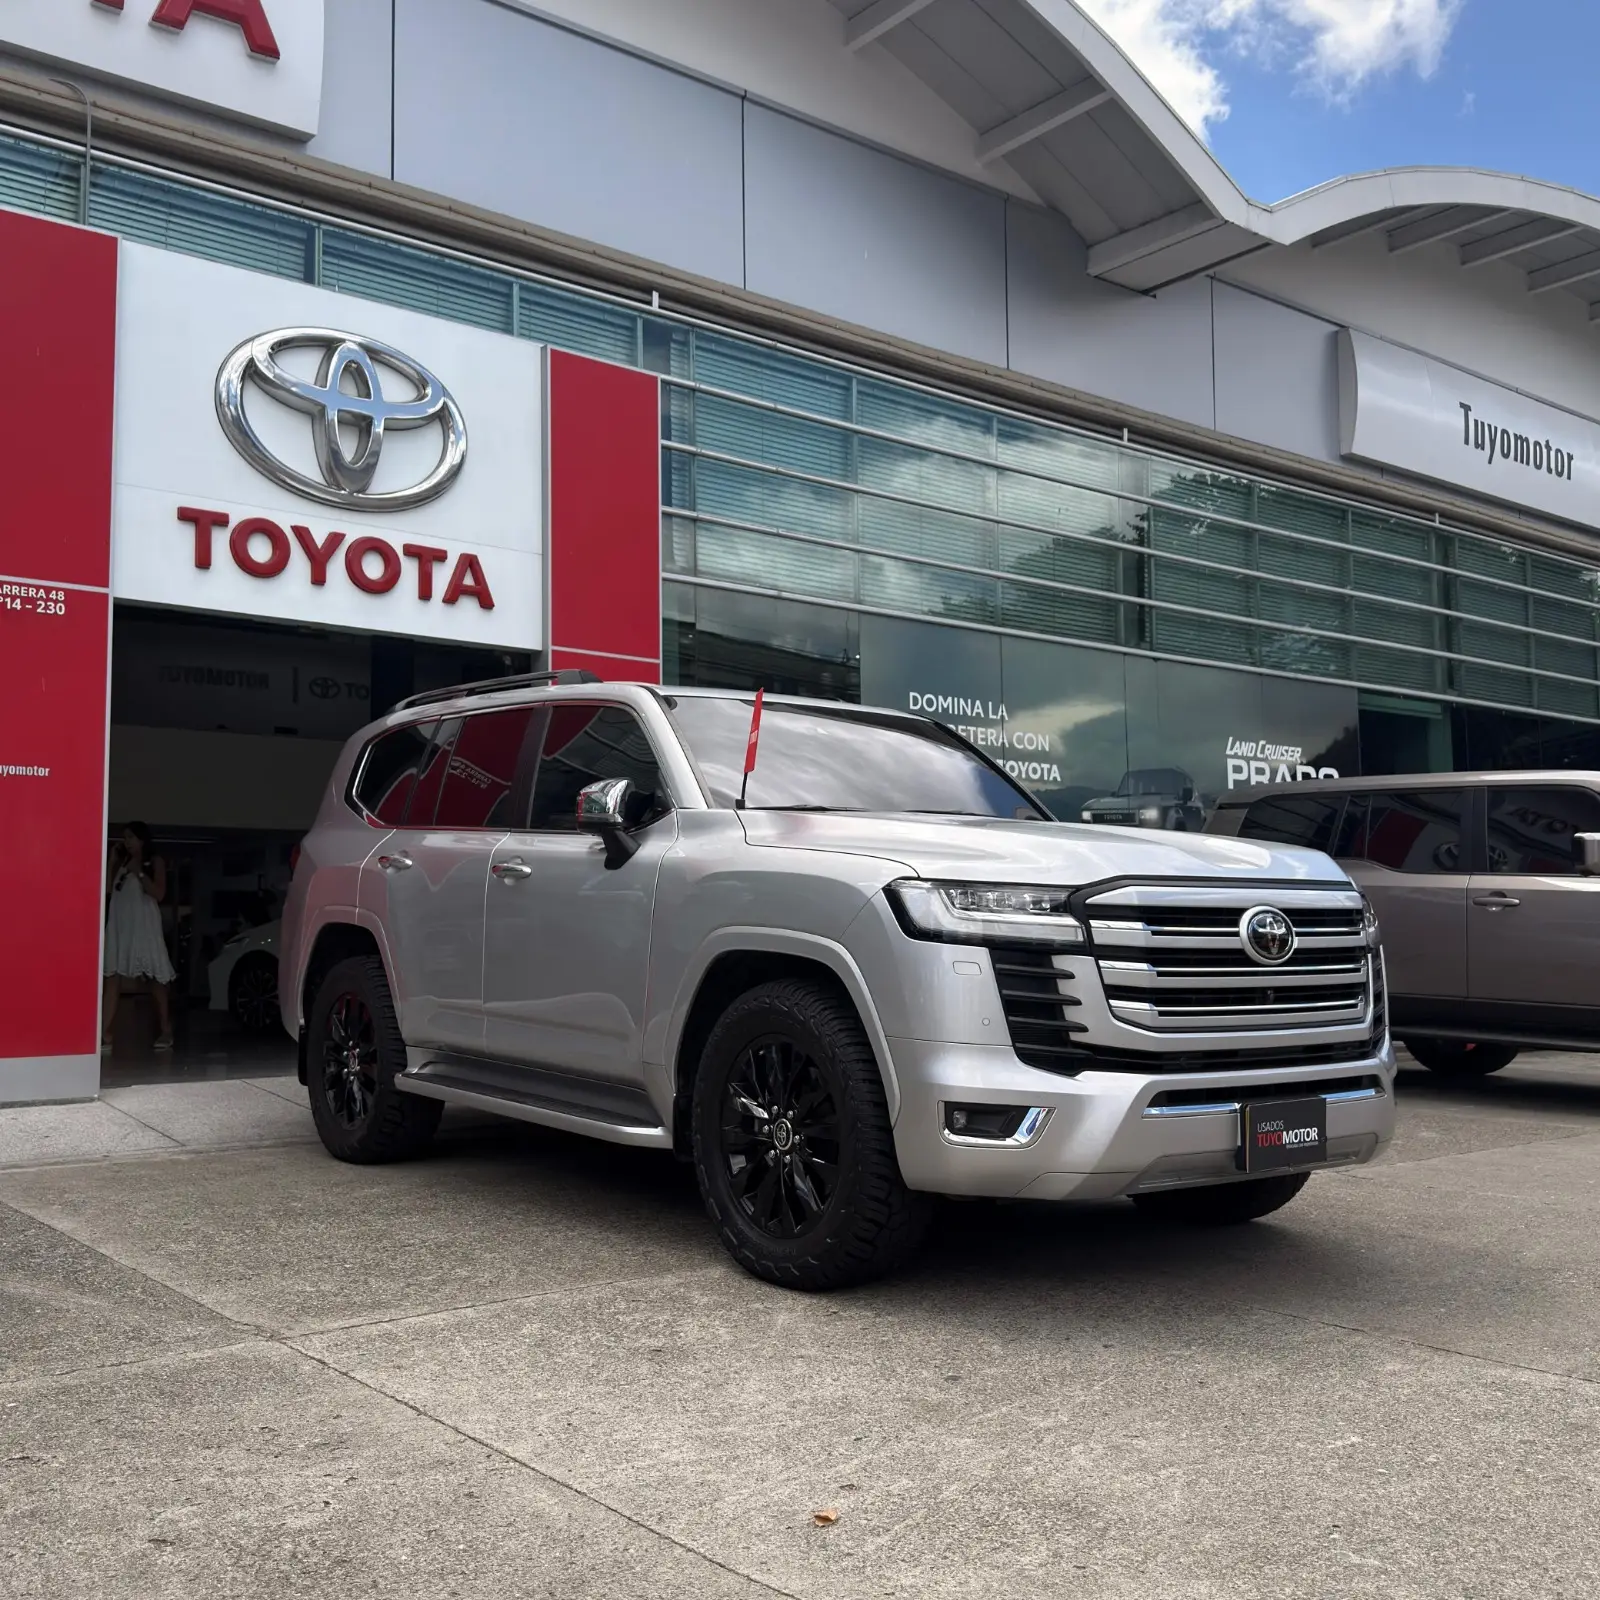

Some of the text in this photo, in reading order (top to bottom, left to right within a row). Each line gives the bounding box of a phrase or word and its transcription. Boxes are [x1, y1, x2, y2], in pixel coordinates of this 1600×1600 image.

[1459, 401, 1574, 481] Tuyomotor
[177, 506, 495, 610] TOYOTA
[49, 591, 65, 601] 48
[36, 601, 66, 615] 230
[909, 691, 1009, 721] DOMINA LA
[1013, 731, 1050, 752] CON
[1226, 736, 1303, 763] LAND CRUISER
[1257, 1120, 1284, 1132] USADOS
[1257, 1127, 1319, 1147] TUYOMOTOR
